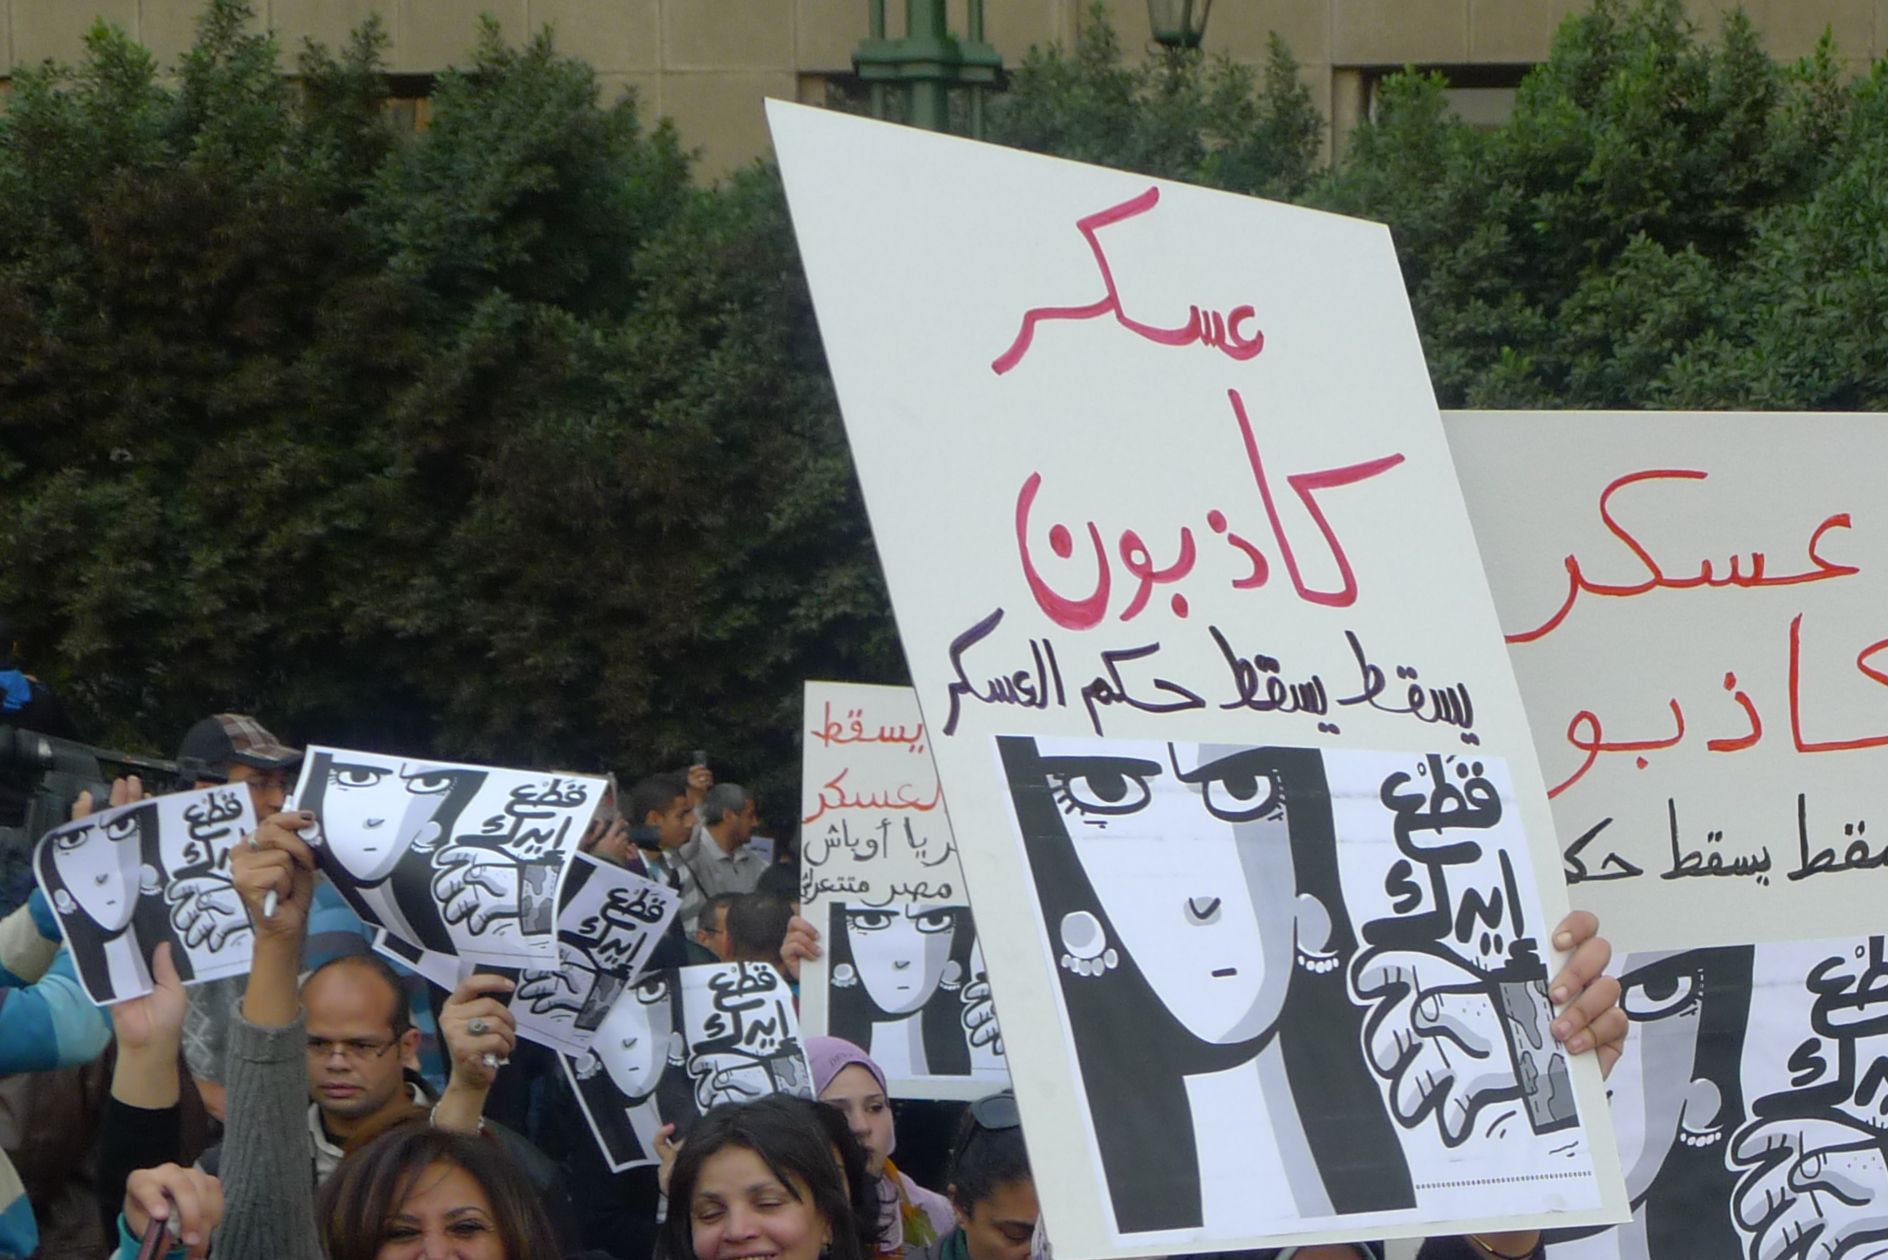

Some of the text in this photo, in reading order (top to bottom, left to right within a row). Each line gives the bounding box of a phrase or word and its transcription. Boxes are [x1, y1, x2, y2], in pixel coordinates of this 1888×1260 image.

[992, 185, 1265, 375] عسكر
[1014, 388, 1406, 631] كاذبون
[1504, 469, 1860, 643] عسكر
[810, 701, 924, 754] يسقط
[942, 609, 1482, 746] يسقط يسقط حكم العسكر
[1563, 817, 1644, 885] حك
[1660, 797, 1772, 886] يسقط
